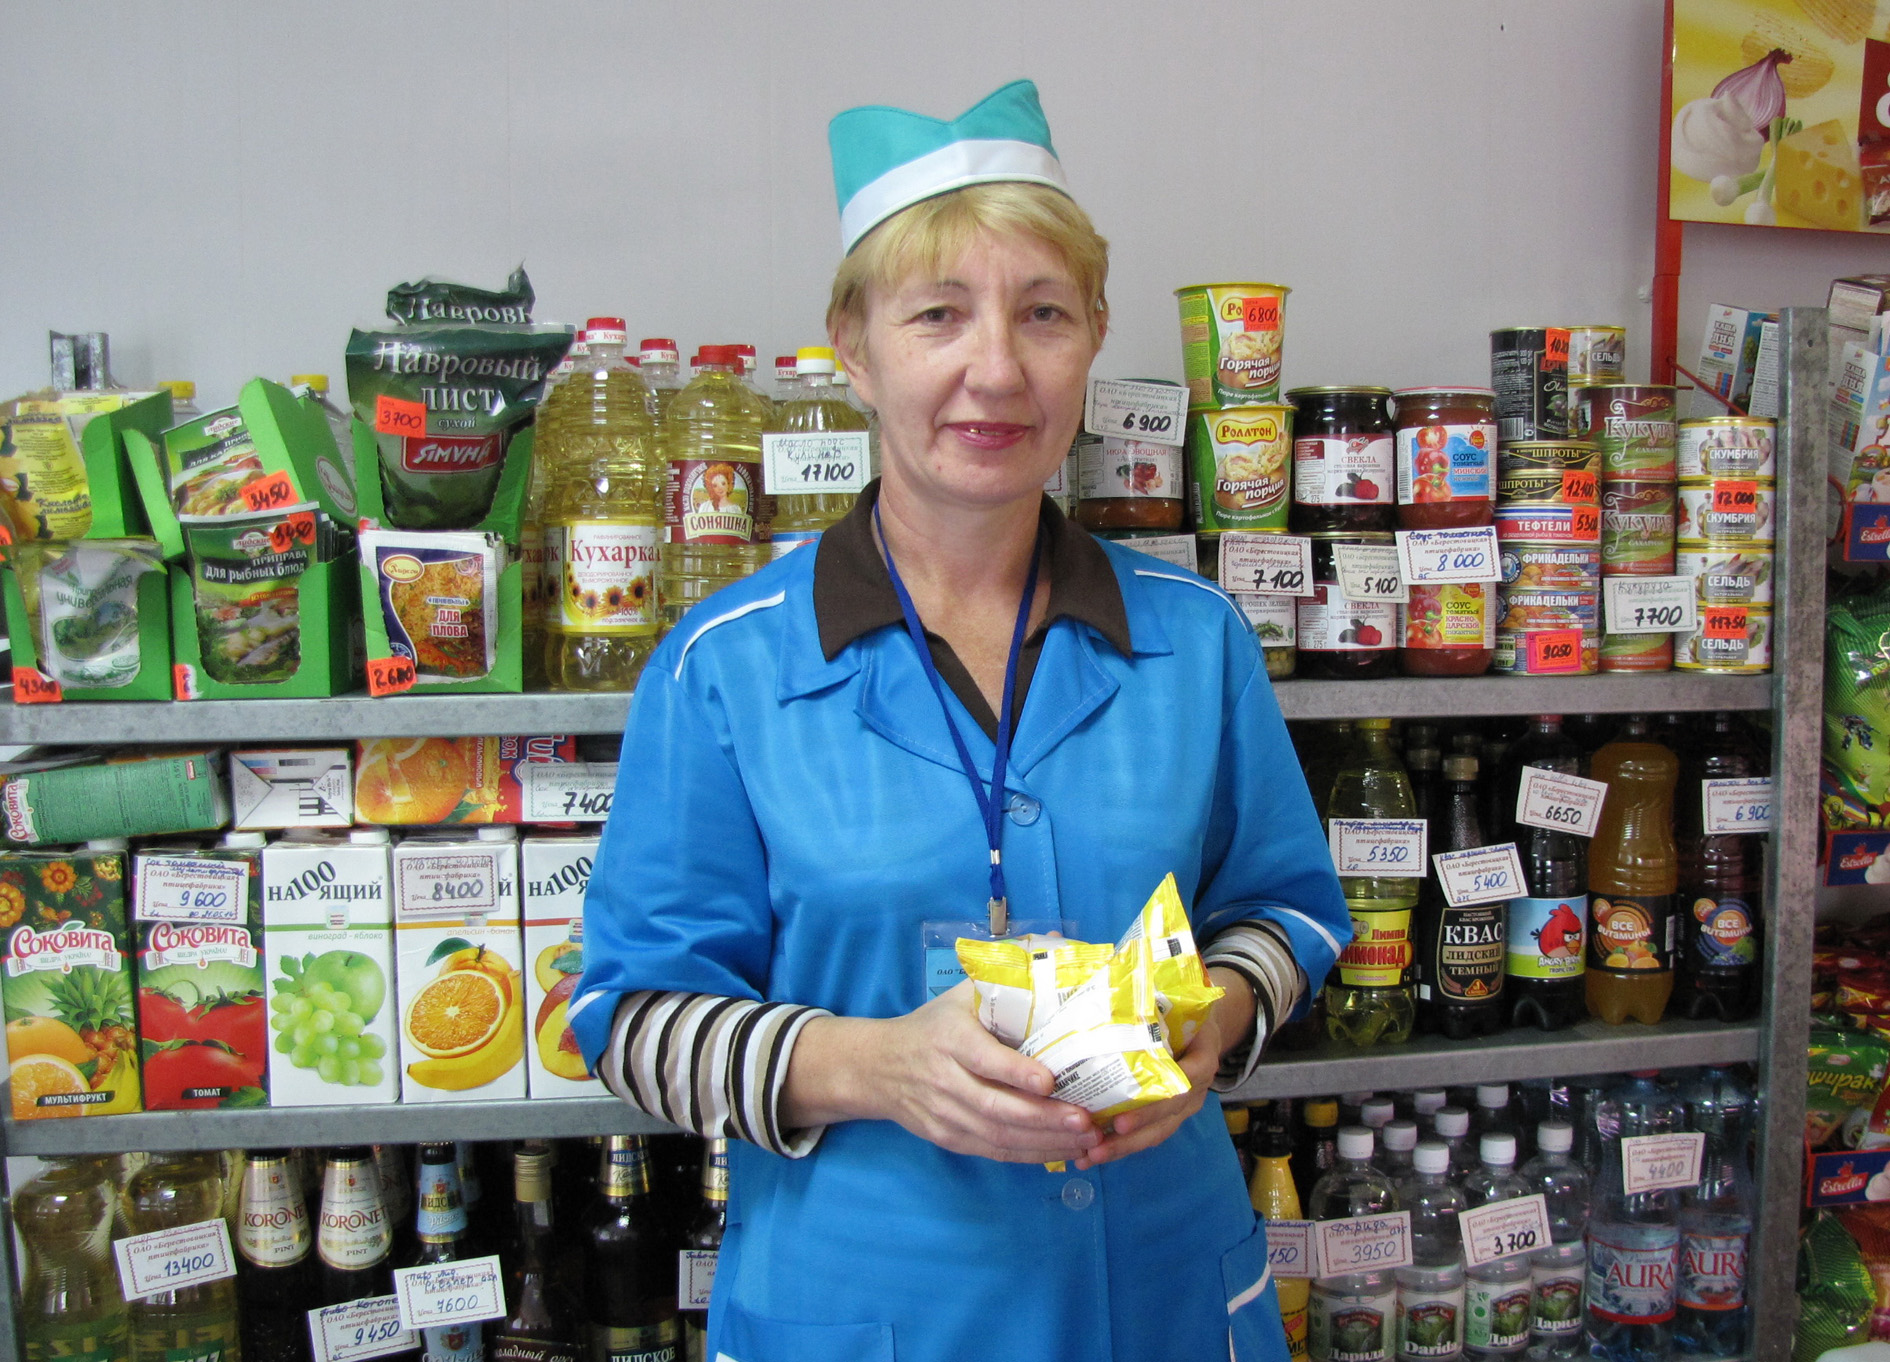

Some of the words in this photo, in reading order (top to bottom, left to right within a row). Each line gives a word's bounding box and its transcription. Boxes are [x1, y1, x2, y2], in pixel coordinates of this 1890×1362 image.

[1249, 306, 1278, 322] 6800
[374, 341, 542, 384] Лавровый
[1219, 357, 1270, 371] Горячая
[1249, 360, 1282, 379] порция
[381, 408, 422, 429] 3700
[438, 416, 477, 429] сухой
[1341, 456, 1378, 464] СВЕКЛА
[1452, 453, 1477, 461] СОУС
[1709, 449, 1759, 459] СКУМБРИЯ
[1216, 477, 1269, 492] Горячая
[1245, 479, 1285, 500] порция
[1706, 512, 1756, 523] СКУМБРИЯ
[1517, 521, 1571, 531] ТЕФТЕЛИ
[252, 550, 308, 566] ПРИПРАВА
[570, 540, 655, 569] Кухарка
[1522, 553, 1589, 565] ФРИКАДЕЛЬКИ
[229, 567, 276, 583] рыбных
[1707, 575, 1750, 588] СЕЛЬДЬ
[1344, 602, 1380, 610] СВЕКЛА
[1446, 602, 1471, 610] СОУС
[1509, 595, 1579, 607] ФРИКАДЕЛЬКИ
[438, 610, 462, 622] ДЛЯ
[1634, 606, 1683, 627] 7700
[432, 625, 468, 637] ПЛОВА
[1445, 622, 1480, 630] ДАРСКИЙ
[1701, 638, 1744, 650] СЕЛЬДЬ
[1545, 805, 1582, 825] 6650
[432, 879, 483, 901] 8400
[1612, 920, 1634, 931] ВСЕ
[1717, 919, 1739, 929] ВСЕ
[152, 921, 250, 951] Соковита
[308, 932, 347, 941] виноград
[1371, 927, 1406, 940] Лимпа
[1444, 921, 1503, 944] КВАС
[1597, 925, 1652, 941] витамины
[14, 925, 113, 960] Соковита
[1537, 956, 1564, 968] ANGRY
[44, 1093, 108, 1105] МУЛЬТИФРУКТ
[193, 1088, 221, 1097] ТОМАТ
[1648, 1161, 1685, 1181] 4400
[322, 1205, 387, 1233] KORONET
[1331, 1219, 1389, 1236] Дарида
[346, 1248, 369, 1256] PINT
[1350, 1241, 1397, 1264] 3950
[164, 1253, 214, 1277] 13400
[1681, 1251, 1748, 1279] AURA
[1606, 1262, 1674, 1291] AURA
[437, 1294, 478, 1313] 7600
